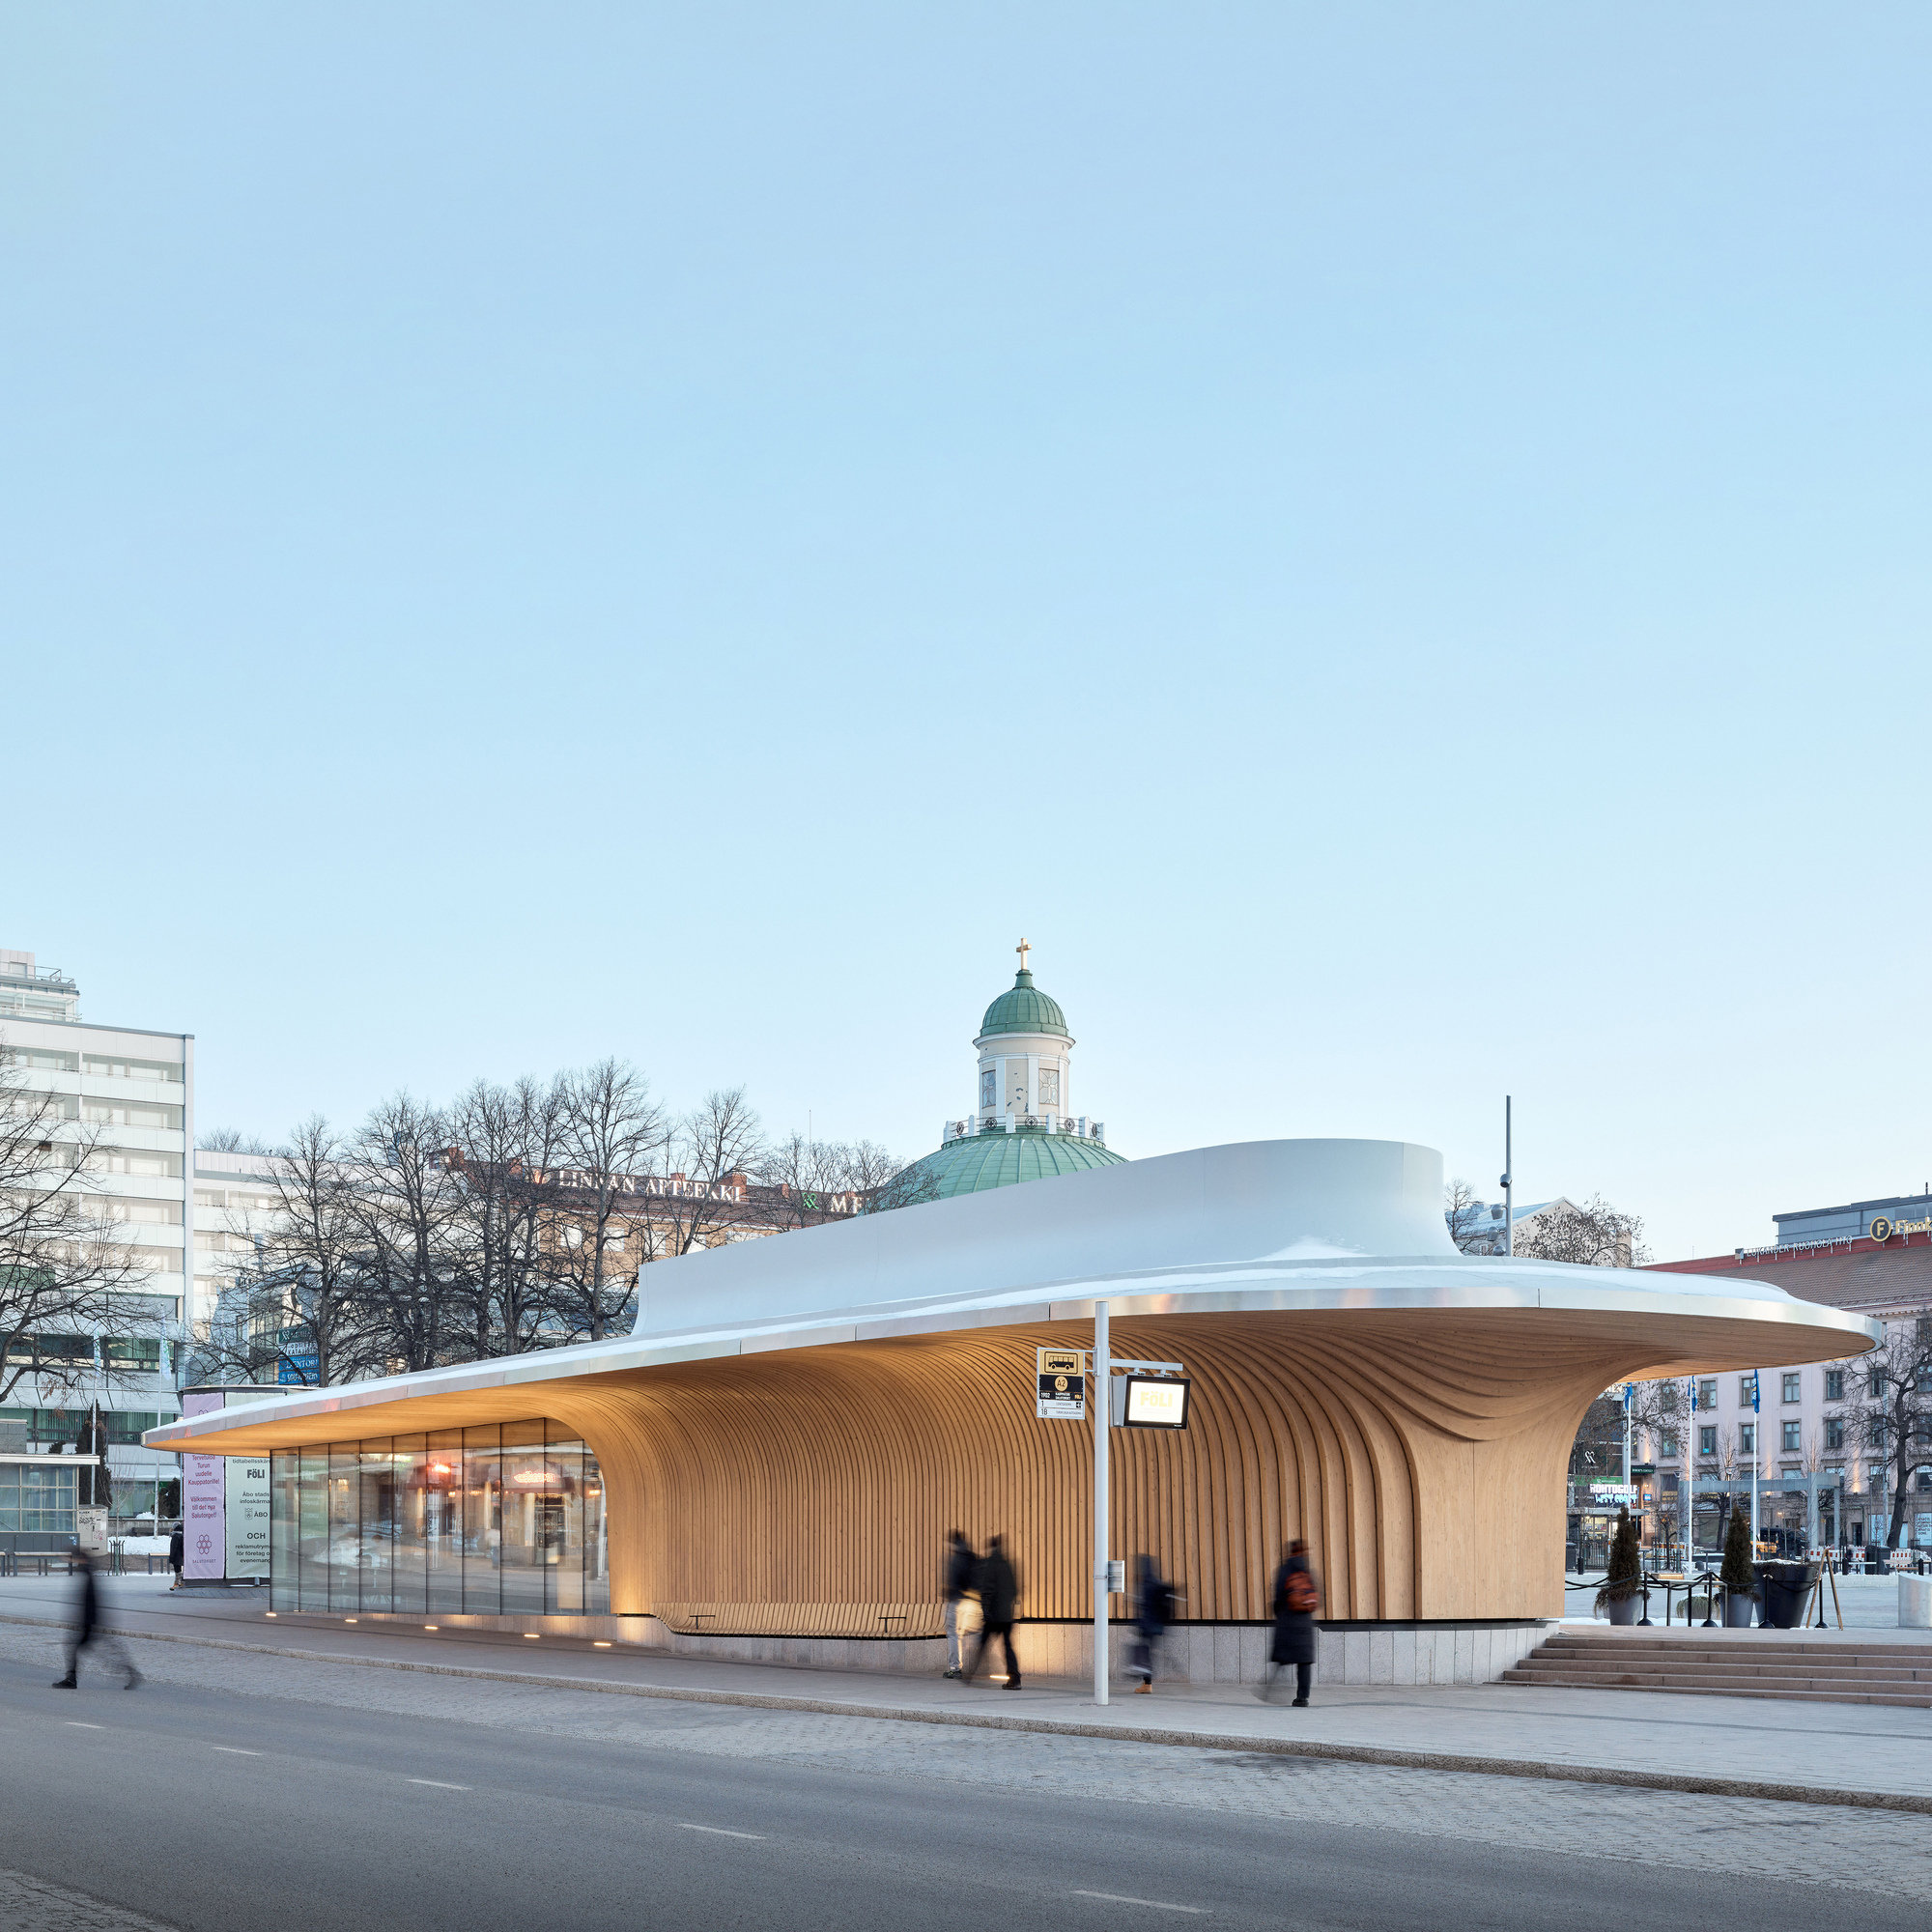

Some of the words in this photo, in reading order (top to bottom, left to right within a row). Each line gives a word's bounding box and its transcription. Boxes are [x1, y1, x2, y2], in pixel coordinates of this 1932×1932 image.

[1140, 1391, 1173, 1407] FÖLI
[246, 1468, 265, 1479] FÖLI
[1614, 1493, 1637, 1504] COAT
